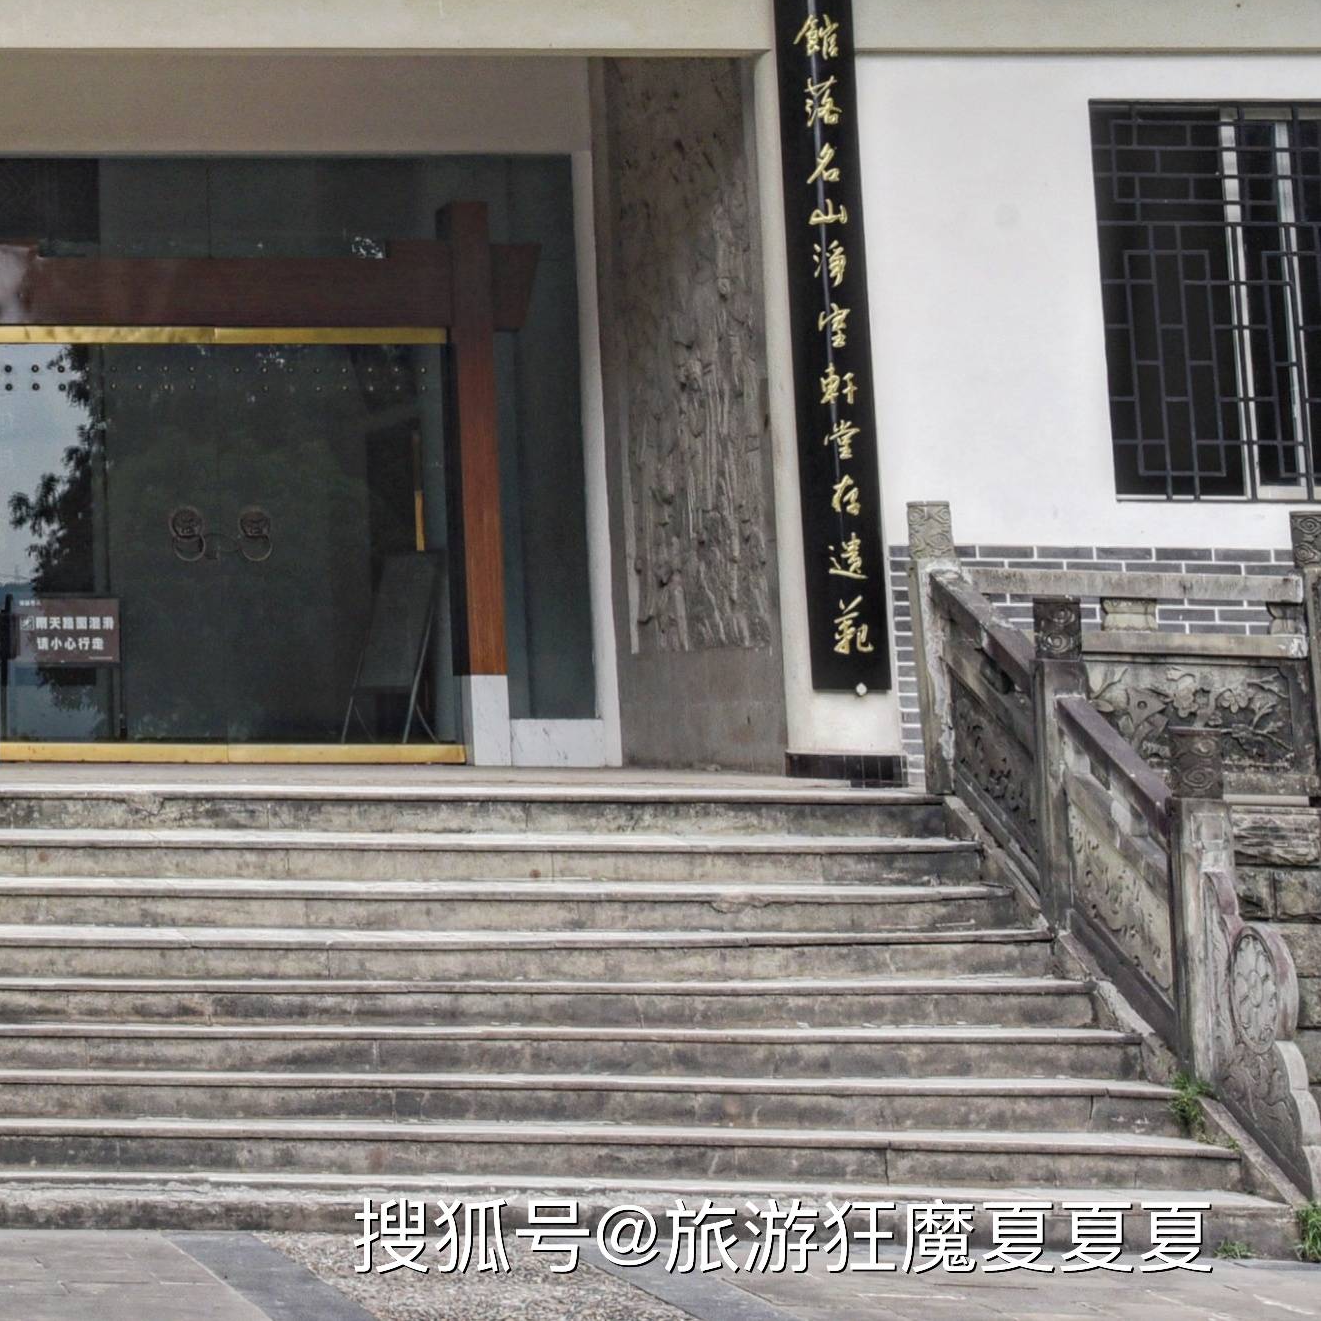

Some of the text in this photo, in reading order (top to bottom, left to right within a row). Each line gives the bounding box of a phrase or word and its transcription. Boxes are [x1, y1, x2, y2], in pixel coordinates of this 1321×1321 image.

[36, 636, 104, 651] 请小心行走
